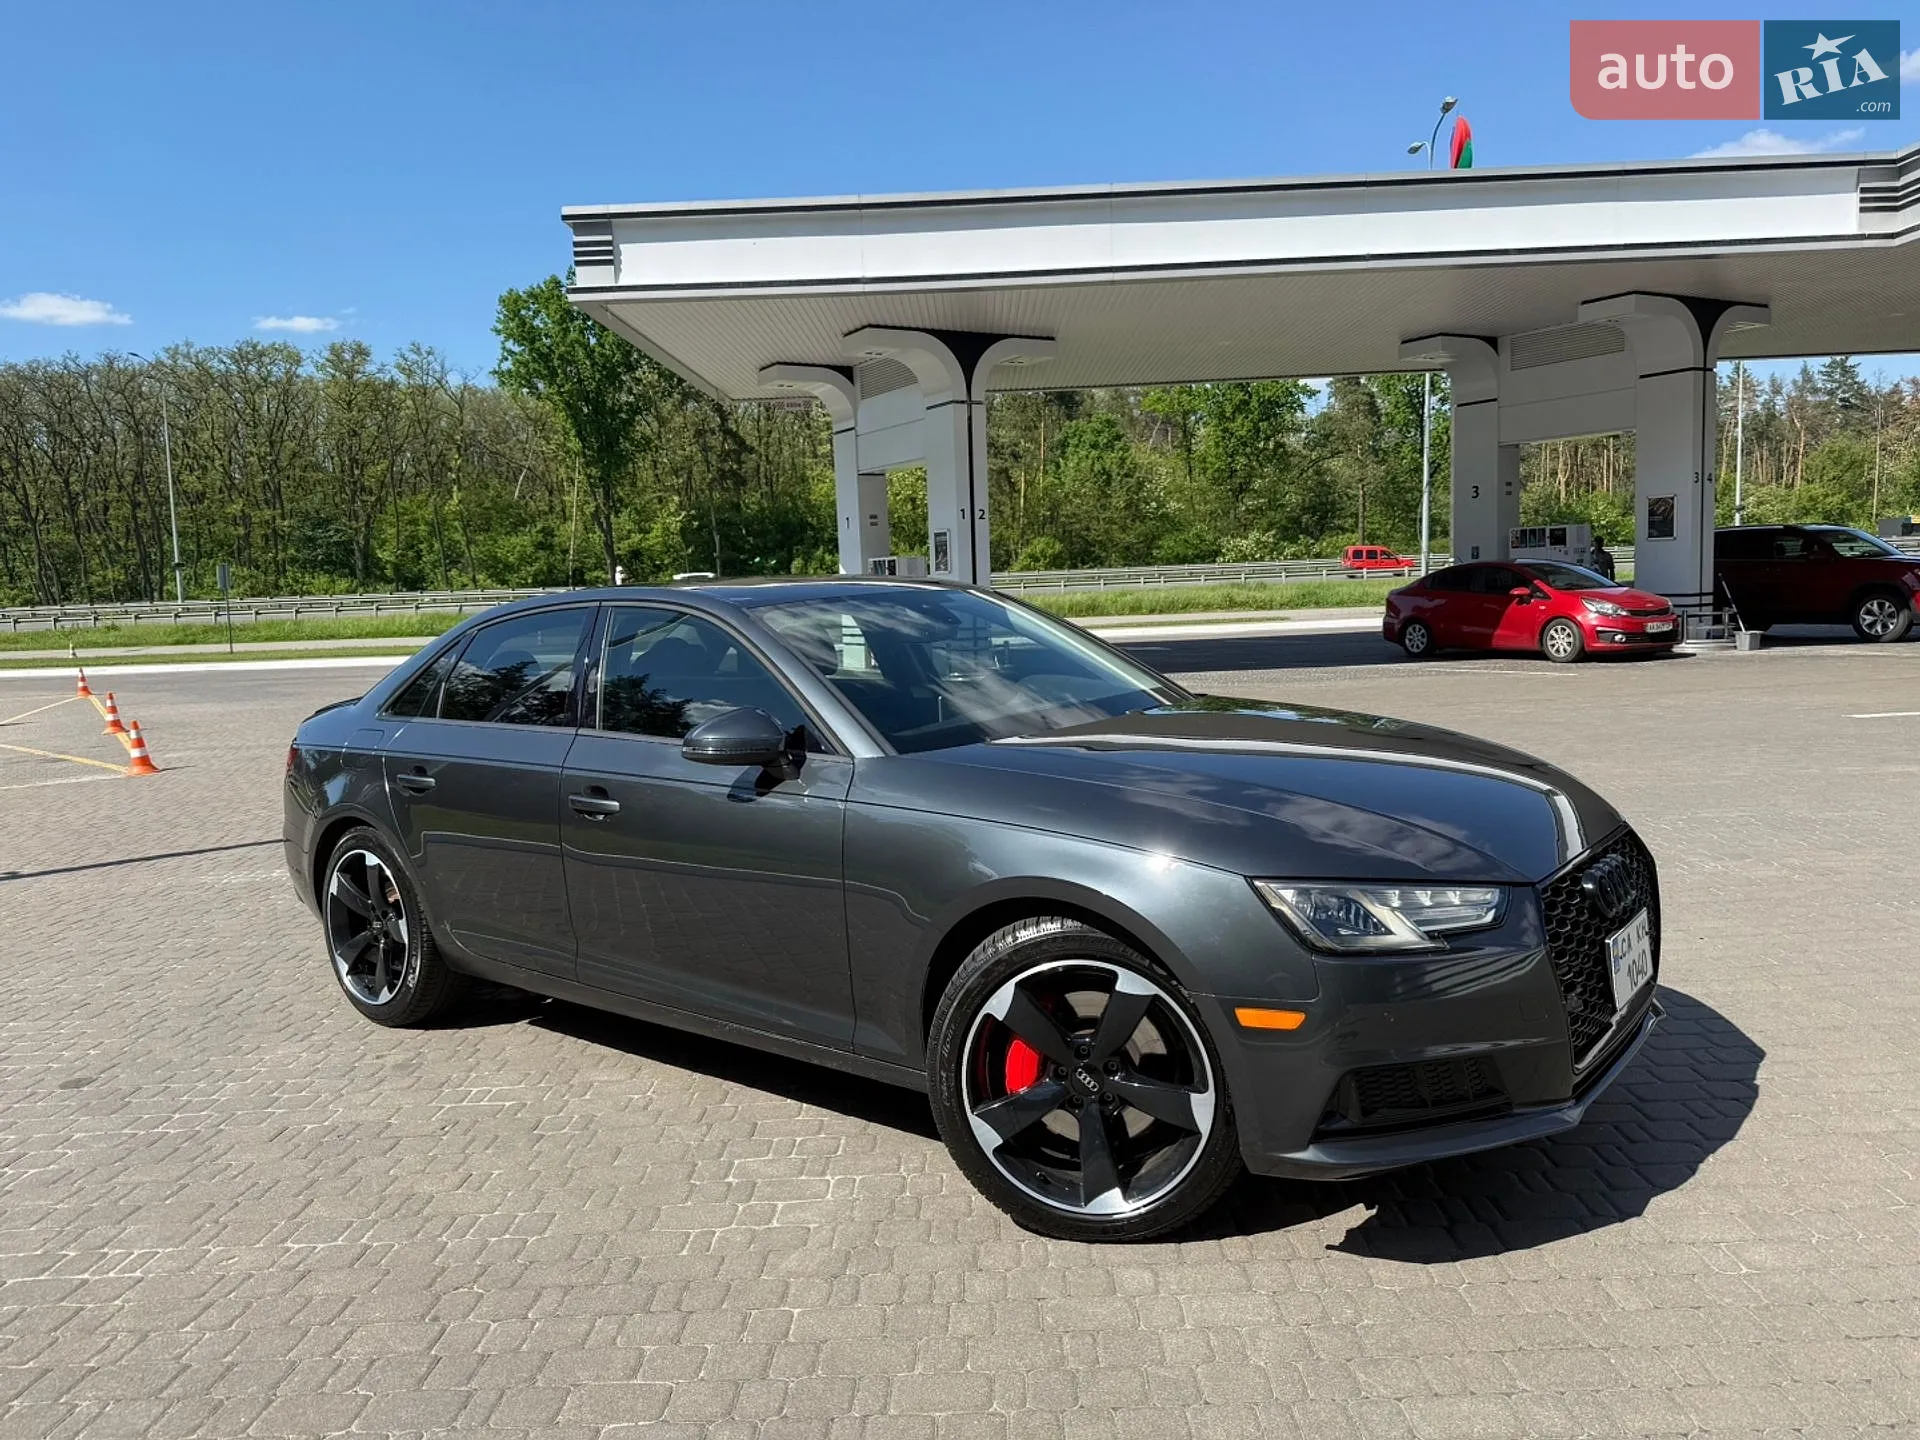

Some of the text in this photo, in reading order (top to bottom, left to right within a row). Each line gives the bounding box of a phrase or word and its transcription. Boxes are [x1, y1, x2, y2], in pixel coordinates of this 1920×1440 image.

[1694, 471, 1713, 485] 3 4
[1471, 485, 1480, 499] 3
[960, 508, 986, 520] 1 2
[1626, 948, 1648, 991] 1040
